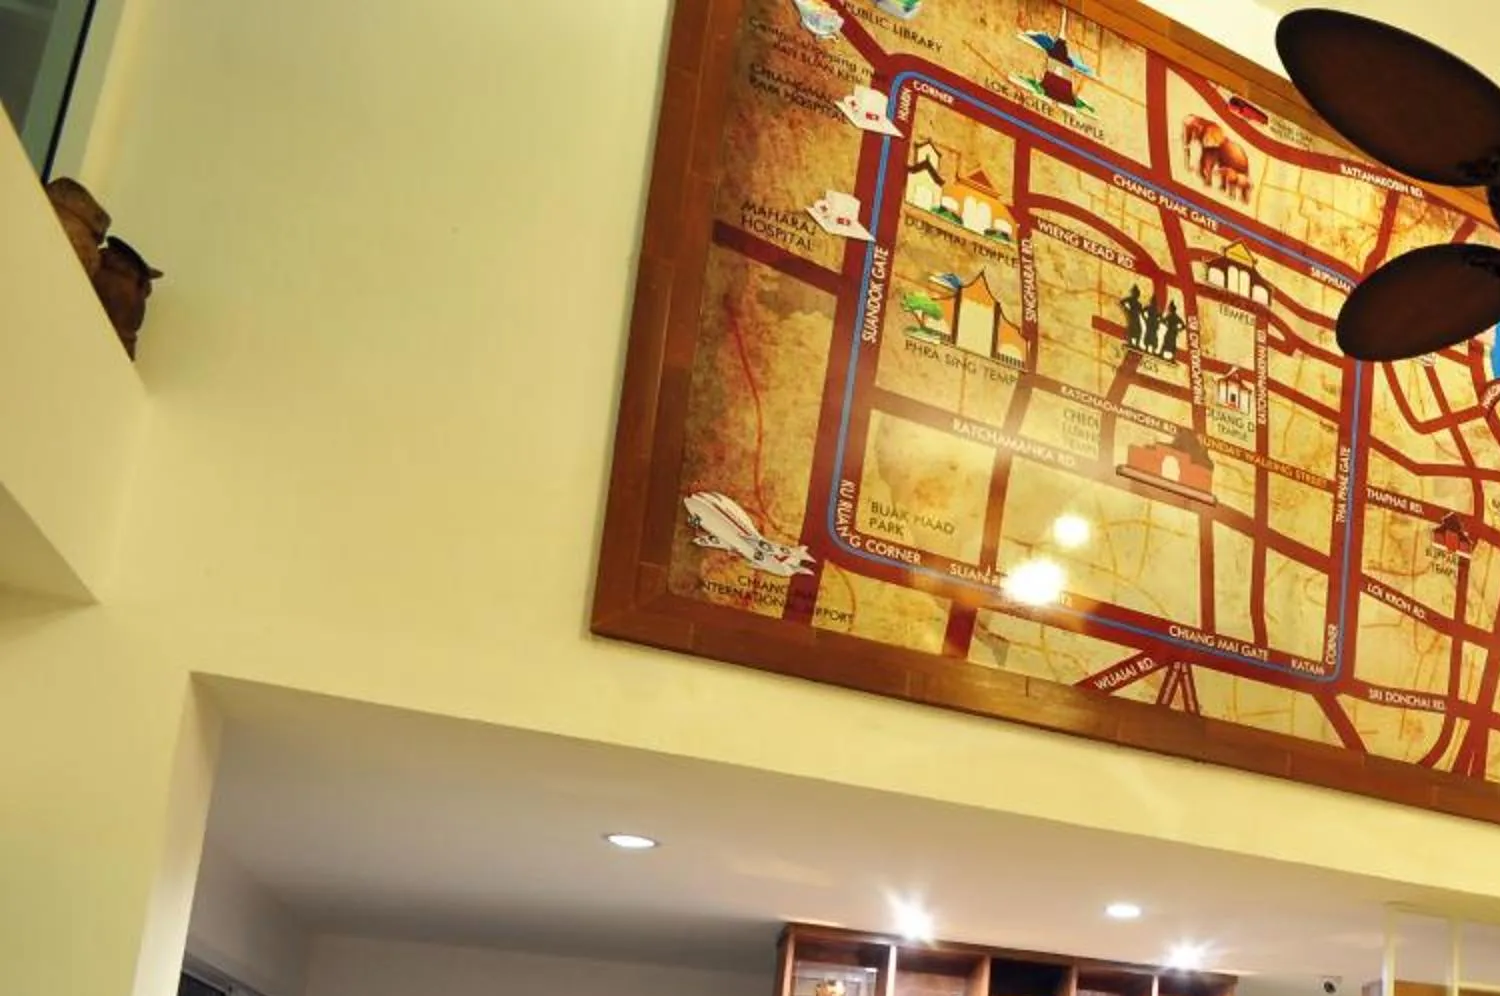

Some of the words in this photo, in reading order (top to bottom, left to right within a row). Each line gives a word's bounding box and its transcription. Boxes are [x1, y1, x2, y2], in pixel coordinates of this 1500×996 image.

[892, 22, 943, 53] LIBRARY
[914, 79, 955, 105] CORNER
[1062, 107, 1105, 141] TEMPLE
[1112, 173, 1156, 202] CHANG
[1190, 206, 1220, 232] GATE
[740, 200, 818, 237] MAHARAJ
[741, 215, 814, 252] HOSPITAL
[1037, 218, 1079, 248] WIENG
[971, 241, 1019, 269] TEMPLE
[862, 281, 886, 344] SUANDOK
[874, 247, 890, 279] GATE
[905, 338, 940, 362] PHRA
[944, 351, 977, 375] SING
[981, 365, 1018, 386] TEMP
[870, 499, 909, 521] BUAK
[868, 518, 905, 537] PARK
[865, 539, 921, 565] CORNER
[1168, 624, 1215, 648] CHIANG
[1217, 637, 1239, 653] MAI
[1325, 623, 1338, 665] CORNER
[1368, 687, 1384, 701] SRI
[1385, 690, 1431, 709] DONCHAI
